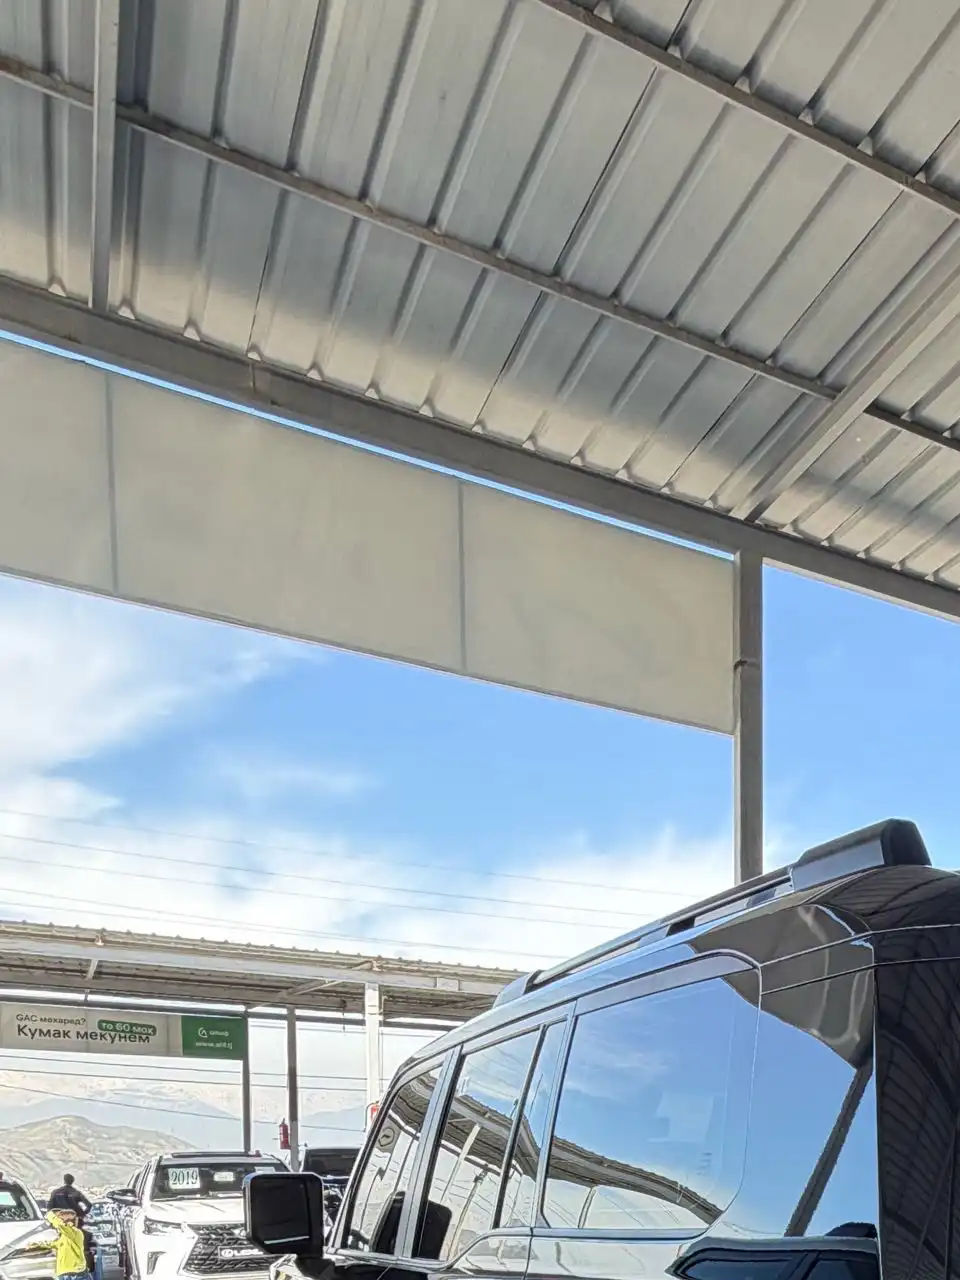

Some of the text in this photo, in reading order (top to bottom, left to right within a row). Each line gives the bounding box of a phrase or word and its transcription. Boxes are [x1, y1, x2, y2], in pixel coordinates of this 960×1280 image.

[16, 1013, 37, 1023] GAC
[116, 1022, 130, 1032] 60
[17, 1024, 150, 1044] Кумак мекунем
[171, 1169, 198, 1185] 2019
